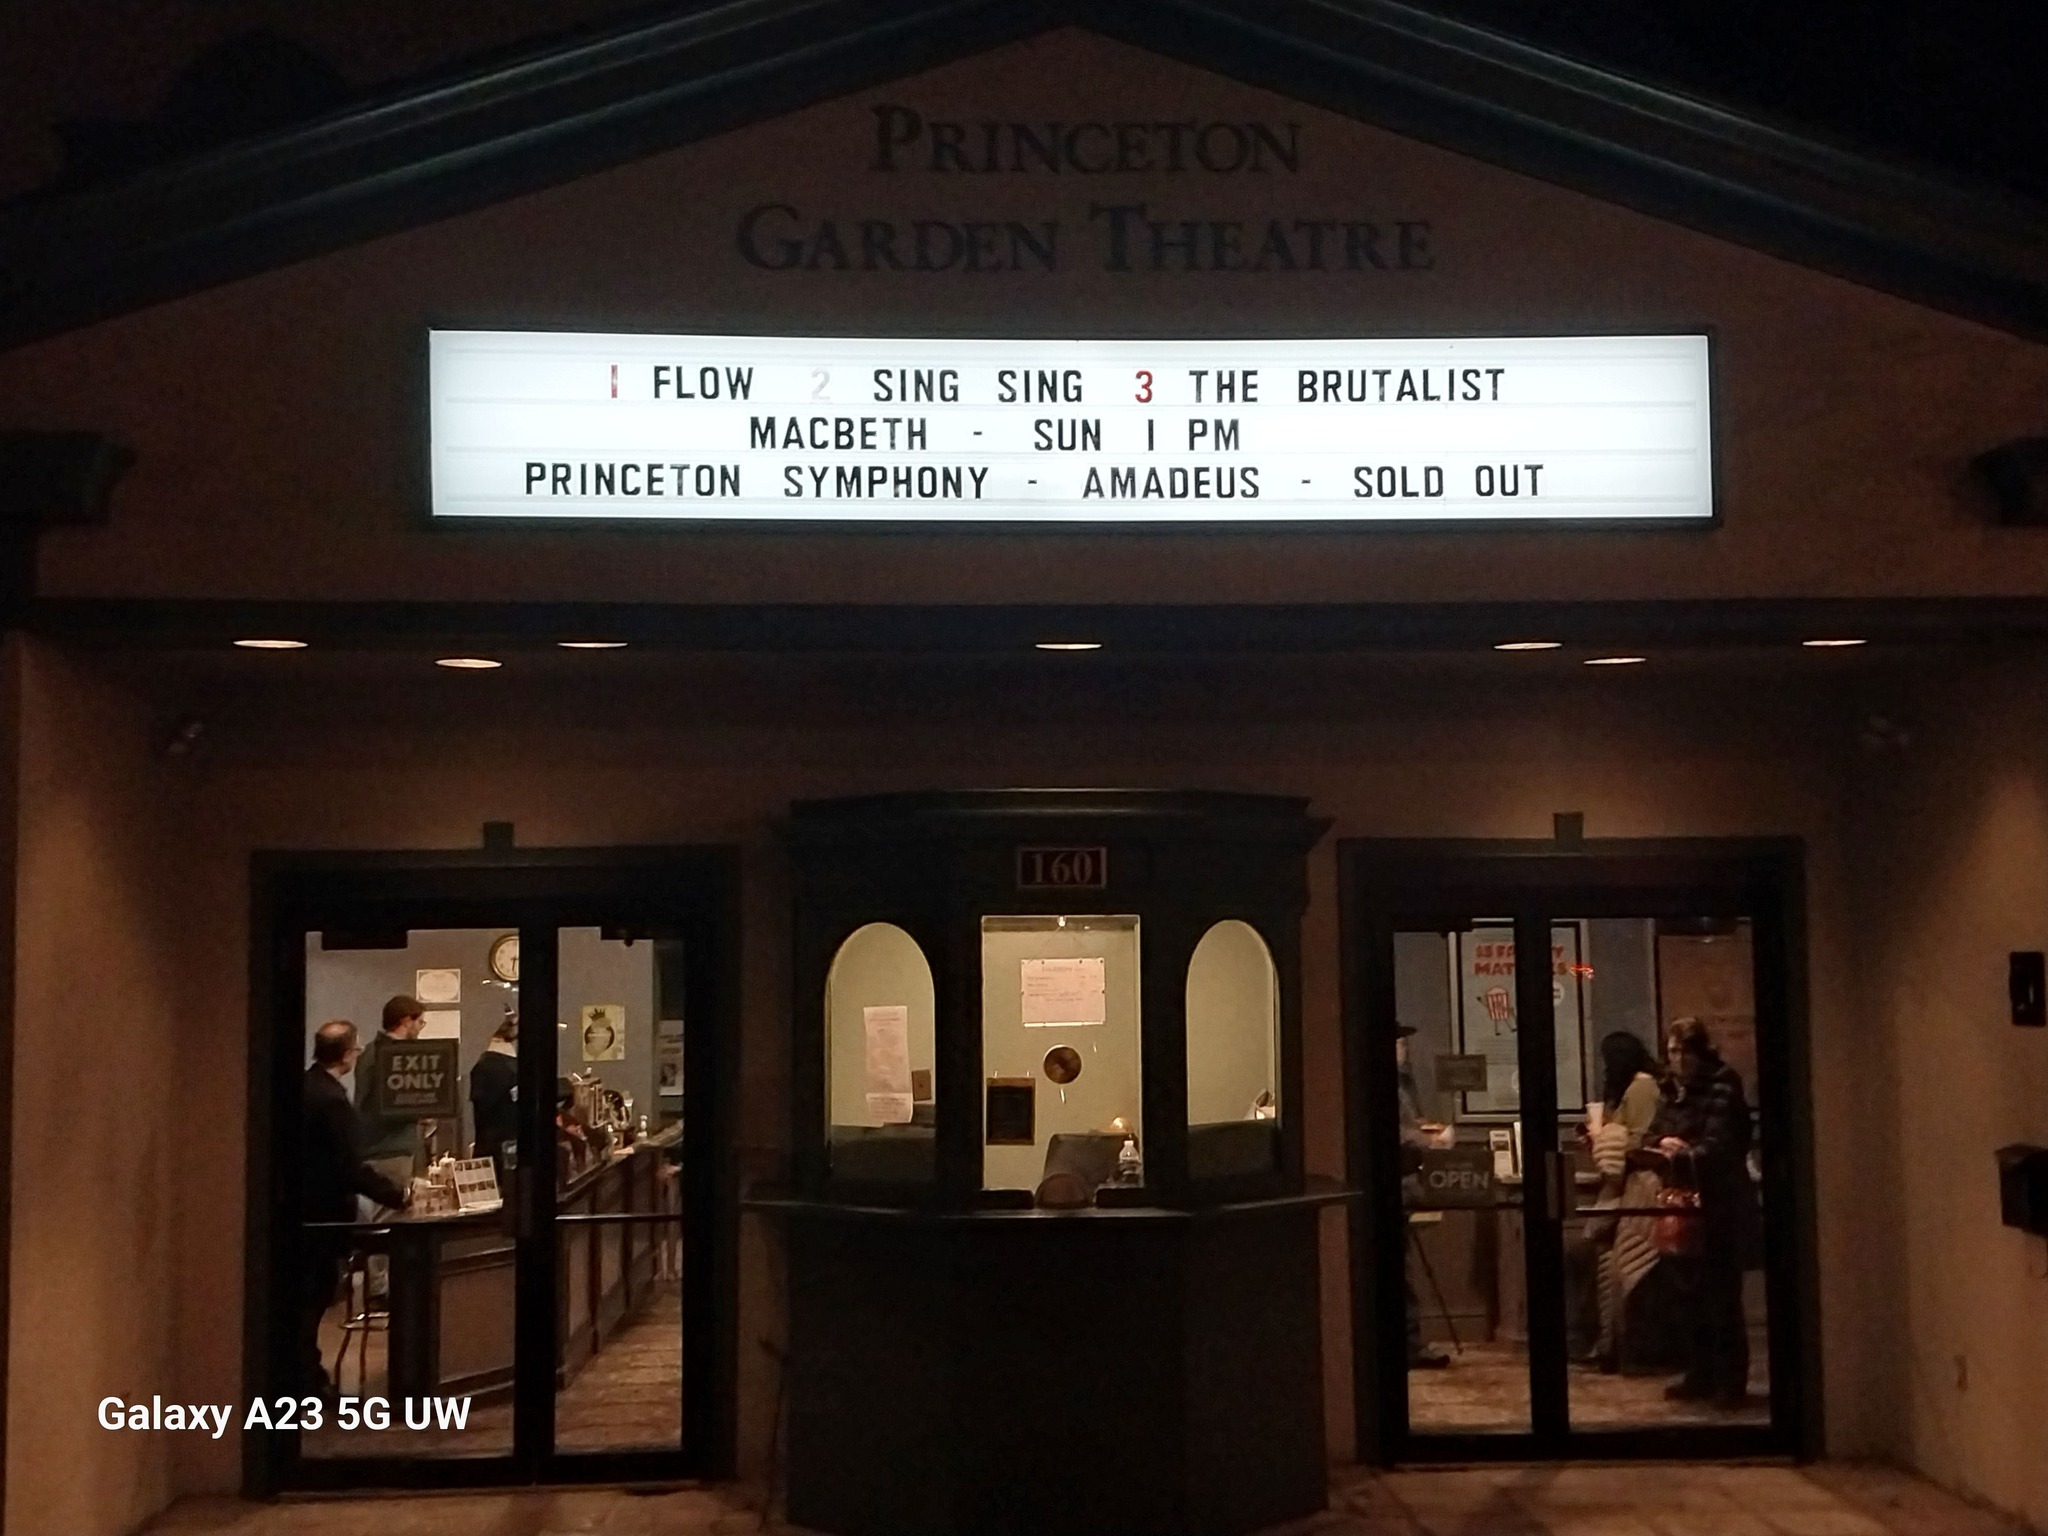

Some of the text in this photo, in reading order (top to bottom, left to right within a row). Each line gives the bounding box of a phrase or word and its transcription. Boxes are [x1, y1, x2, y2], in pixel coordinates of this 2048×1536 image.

[868, 104, 1301, 174] PRINCETON
[736, 202, 1437, 274] GARDEN THEATRE
[653, 365, 754, 400] FLOW
[811, 367, 832, 402] 2
[873, 369, 959, 403] SING
[998, 369, 1082, 403] SING
[1135, 370, 1153, 403] 3
[1189, 370, 1258, 403] THE
[1298, 368, 1505, 403] BRUTALIST
[750, 416, 927, 450] MACBETH
[1034, 418, 1101, 451] SUN
[1188, 419, 1240, 451] PM
[525, 462, 741, 497] PRINCETON
[784, 465, 989, 499] SYMPHONY
[1082, 466, 1260, 499] AMADEUS
[1354, 466, 1444, 498] SOLD
[1475, 464, 1544, 497] OUT
[1031, 851, 1093, 884] 160
[392, 1055, 441, 1071] EXIT
[387, 1073, 444, 1090] ONLY
[1429, 1170, 1490, 1189] OPEN
